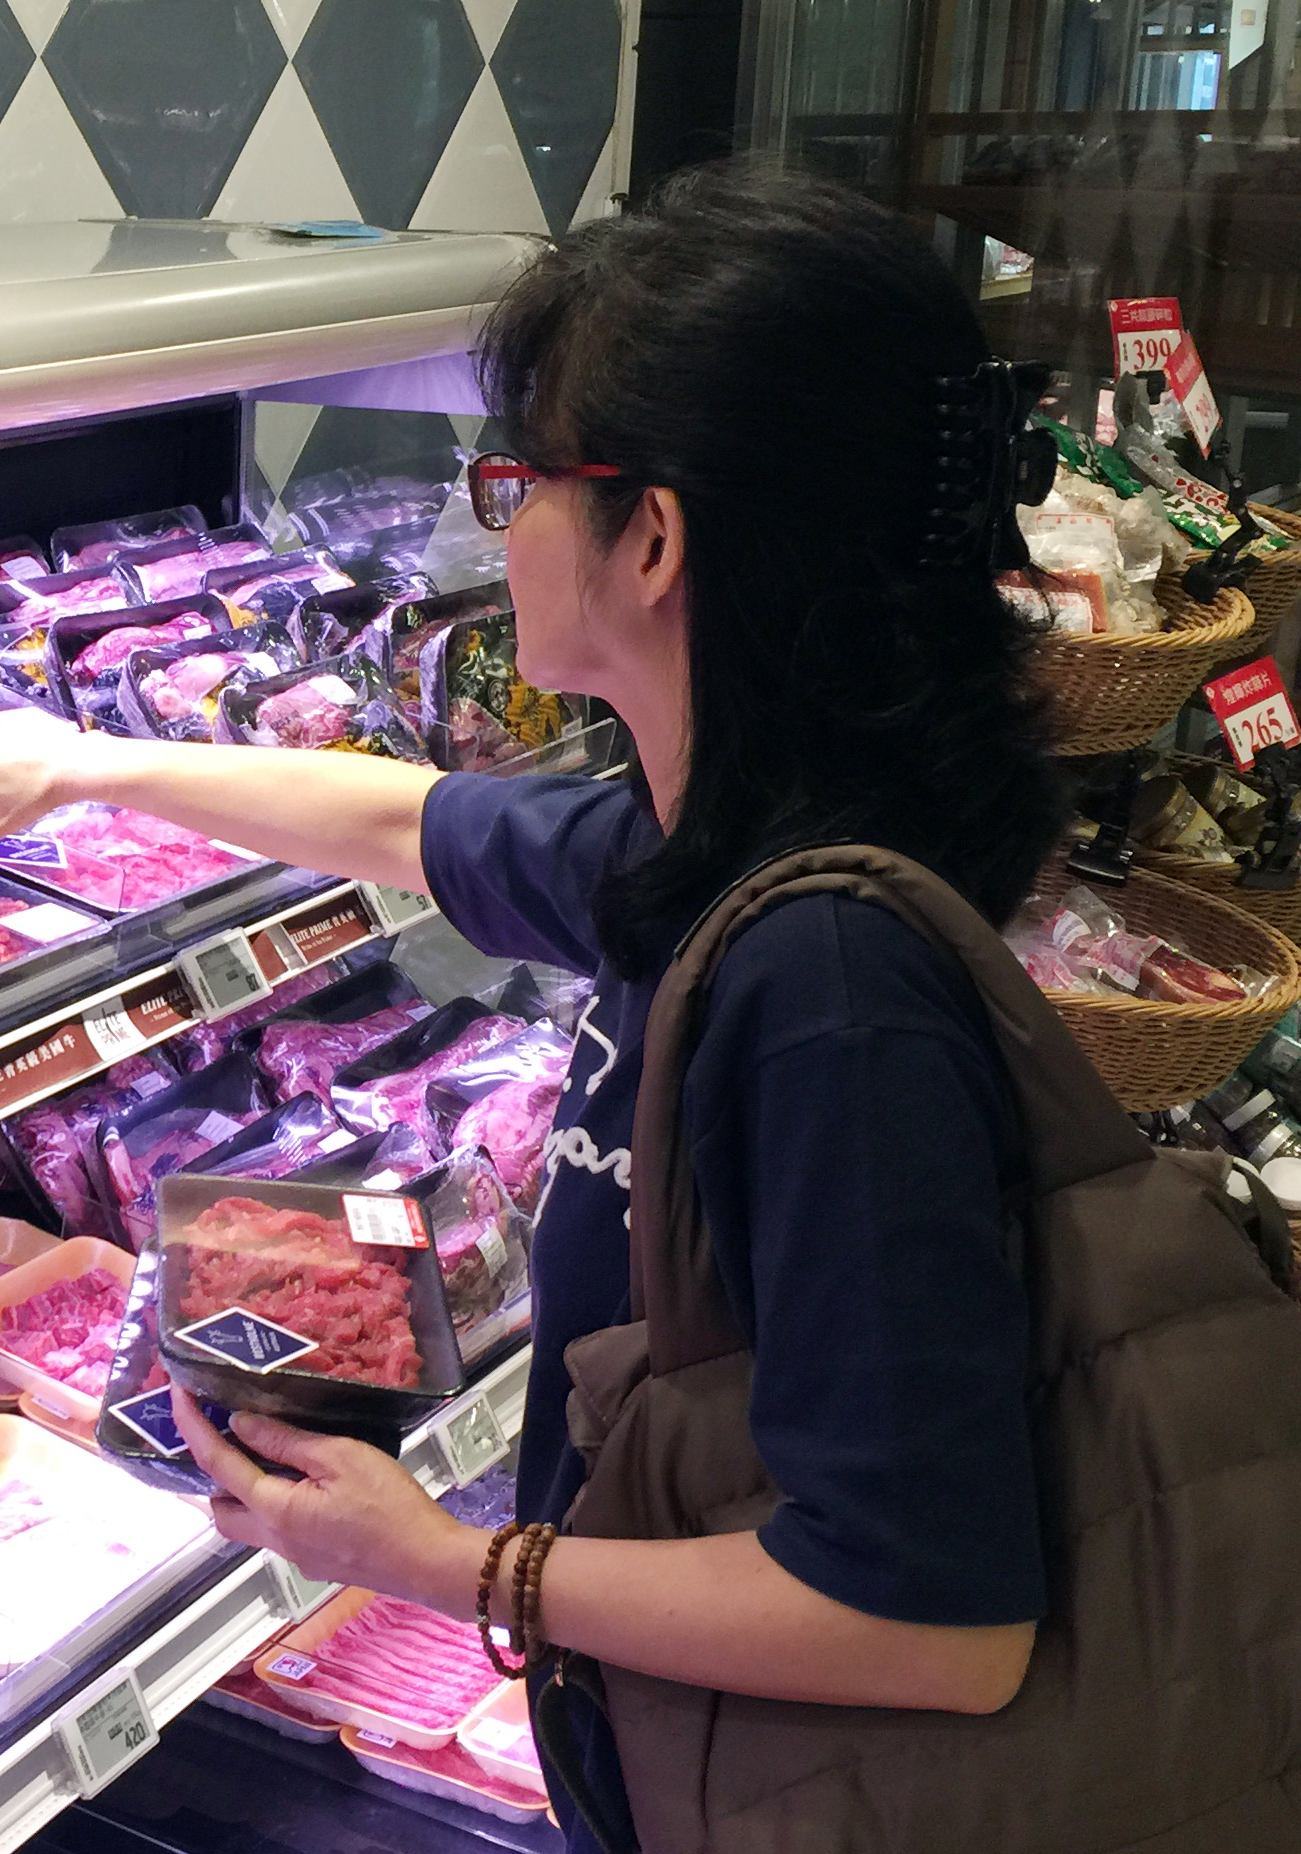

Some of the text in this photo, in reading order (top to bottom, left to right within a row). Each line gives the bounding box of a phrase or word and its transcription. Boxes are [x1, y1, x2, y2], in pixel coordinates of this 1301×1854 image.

[1132, 337, 1172, 371] 399
[1241, 706, 1284, 753] 265
[245, 972, 261, 992] 87
[140, 995, 168, 1015] ELITE
[92, 1007, 121, 1033] ELITE
[125, 1721, 146, 1750] 420
